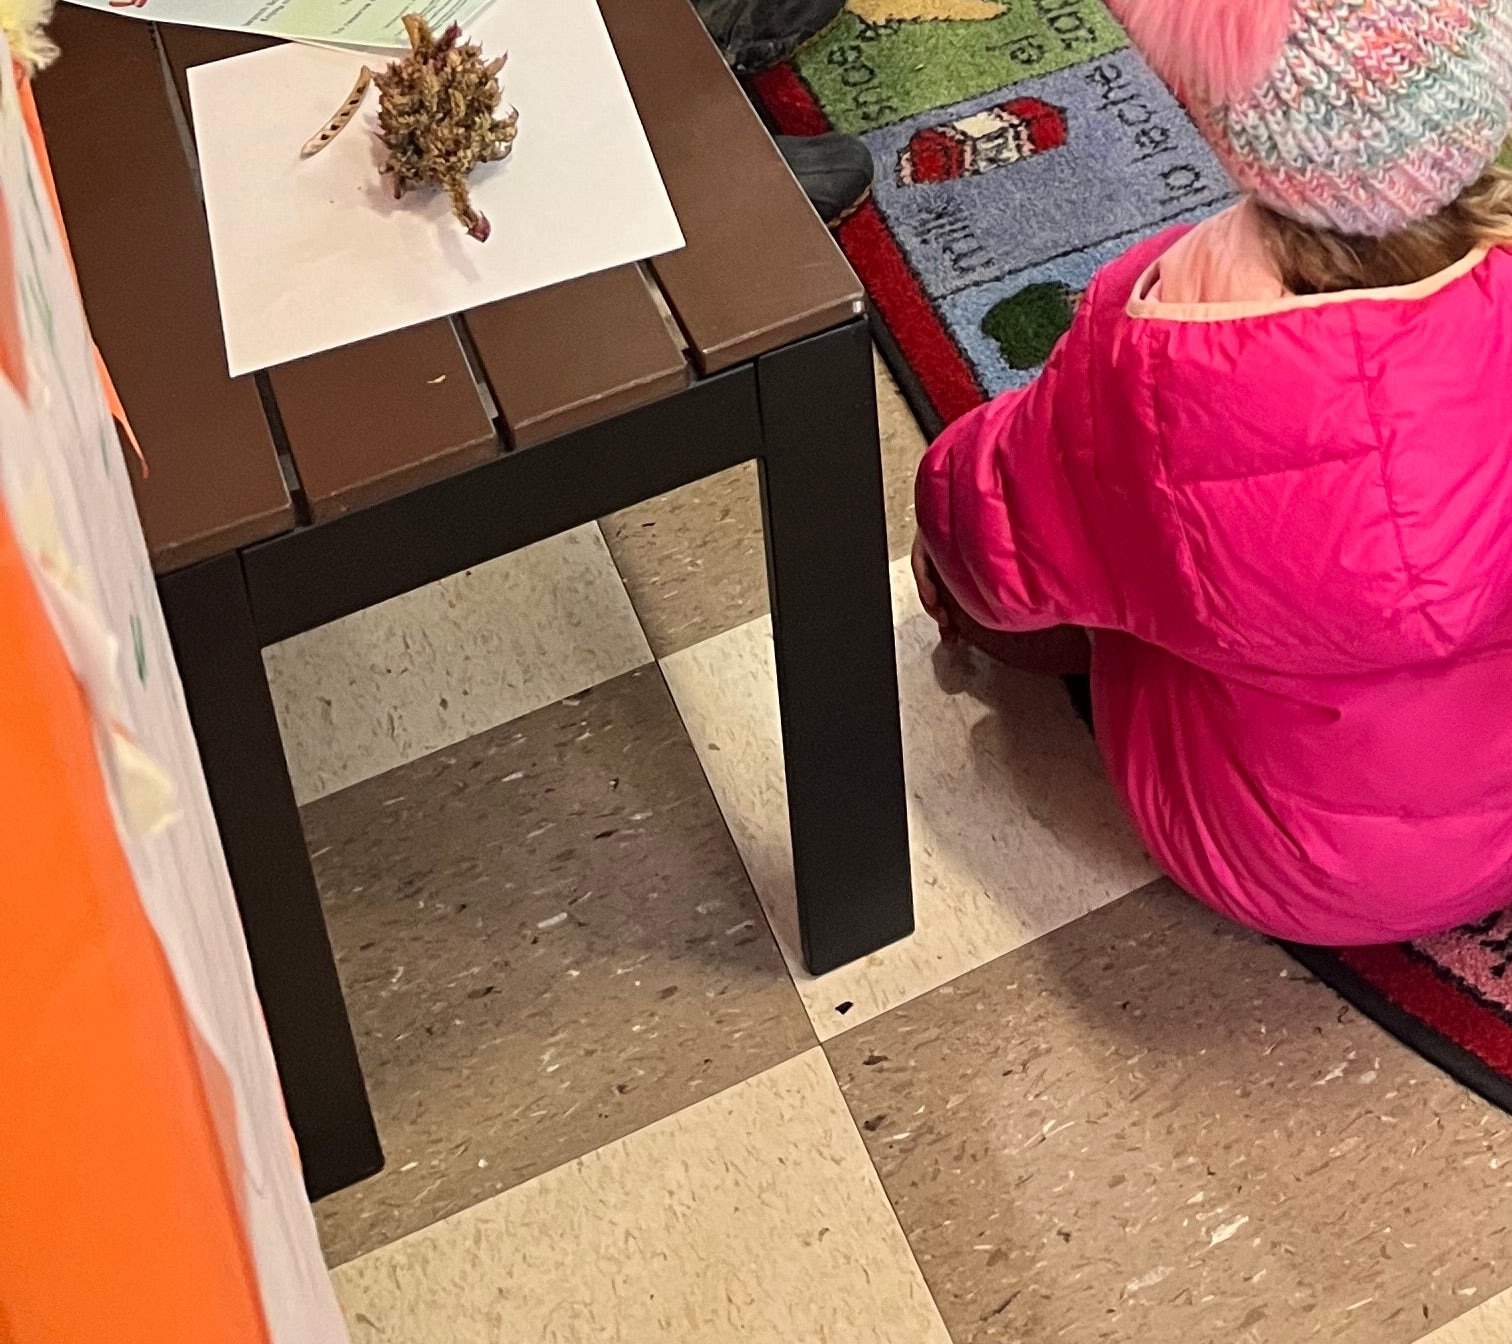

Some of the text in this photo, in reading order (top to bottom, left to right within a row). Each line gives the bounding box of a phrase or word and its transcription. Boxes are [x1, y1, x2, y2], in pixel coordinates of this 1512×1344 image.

[985, 34, 1046, 65] el
[1086, 62, 1180, 166] leche
[917, 197, 997, 275] milk
